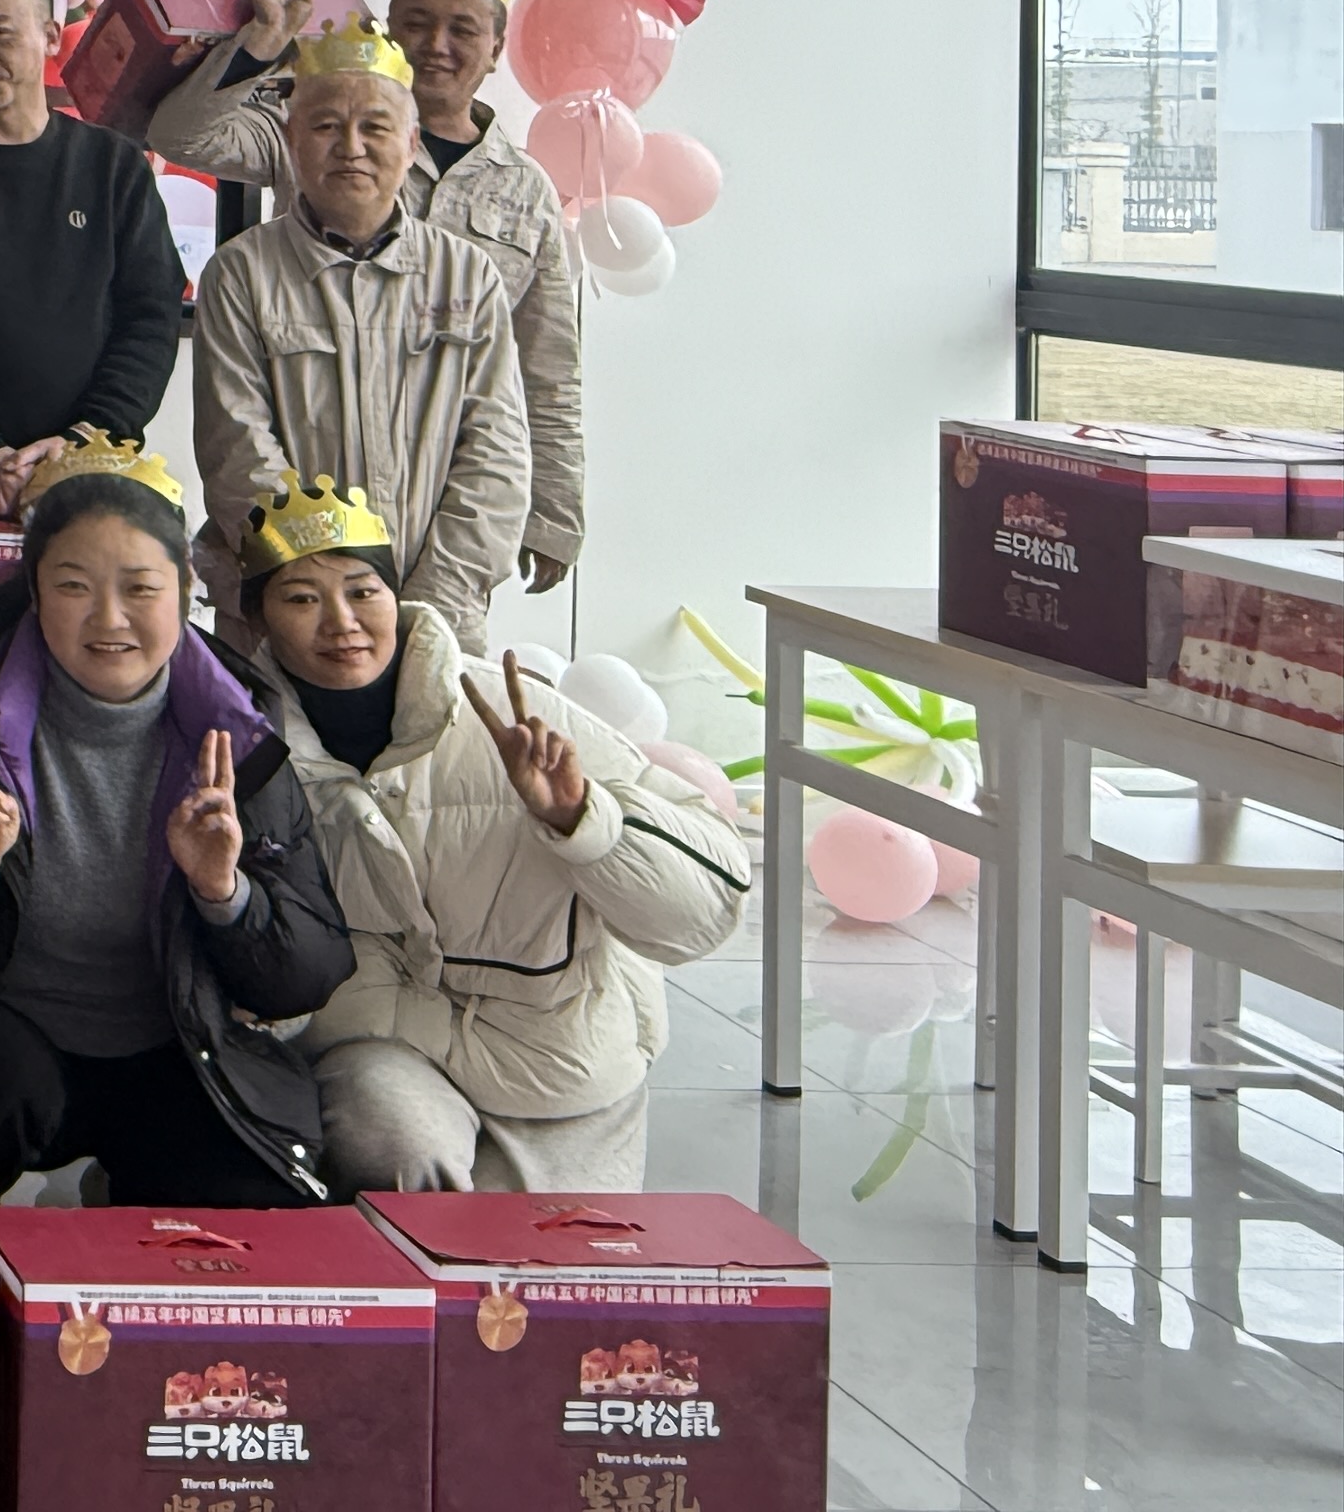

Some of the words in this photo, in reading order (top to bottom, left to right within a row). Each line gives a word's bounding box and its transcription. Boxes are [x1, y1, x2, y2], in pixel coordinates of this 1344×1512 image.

[562, 1400, 721, 1439] 三只松鼠
[146, 1423, 310, 1463] 三只松鼠
